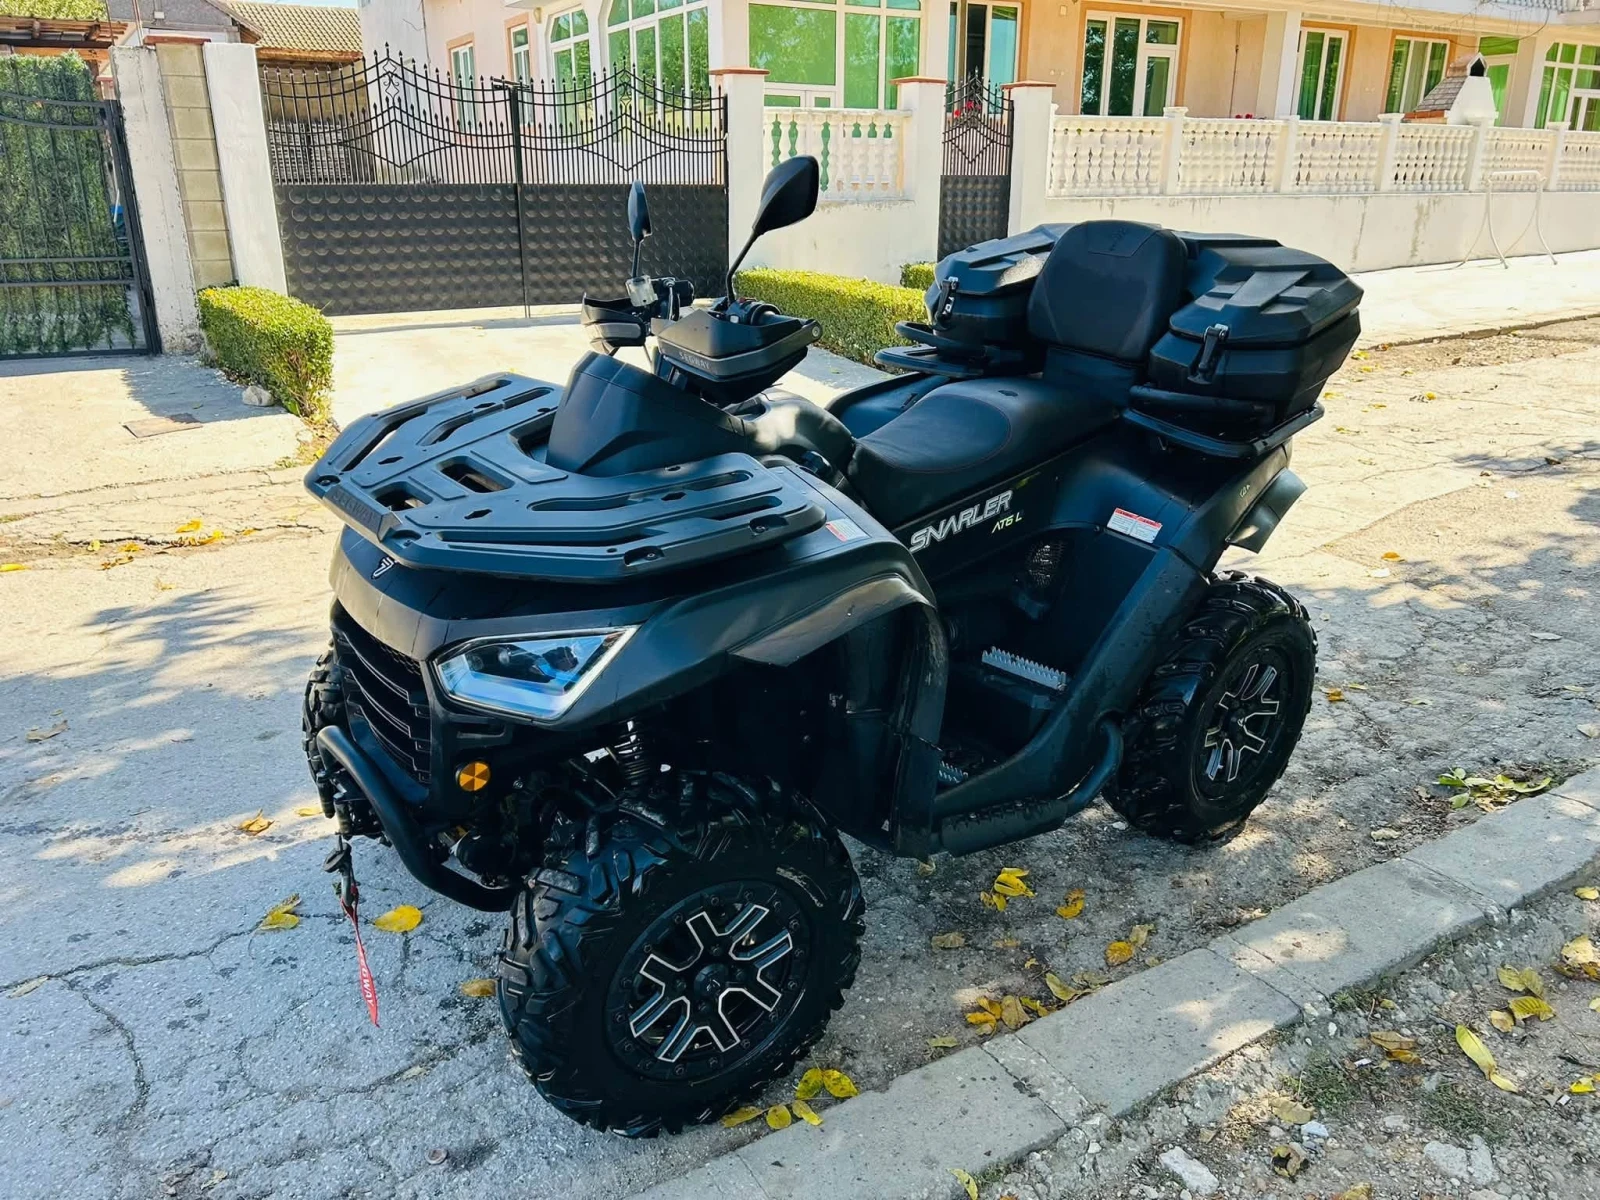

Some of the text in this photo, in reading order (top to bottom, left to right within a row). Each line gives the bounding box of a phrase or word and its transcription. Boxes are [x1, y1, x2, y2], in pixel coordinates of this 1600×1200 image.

[679, 352, 710, 370] SEGWAY
[909, 490, 1013, 553] SNARLER
[991, 511, 1022, 534] AT6 L
